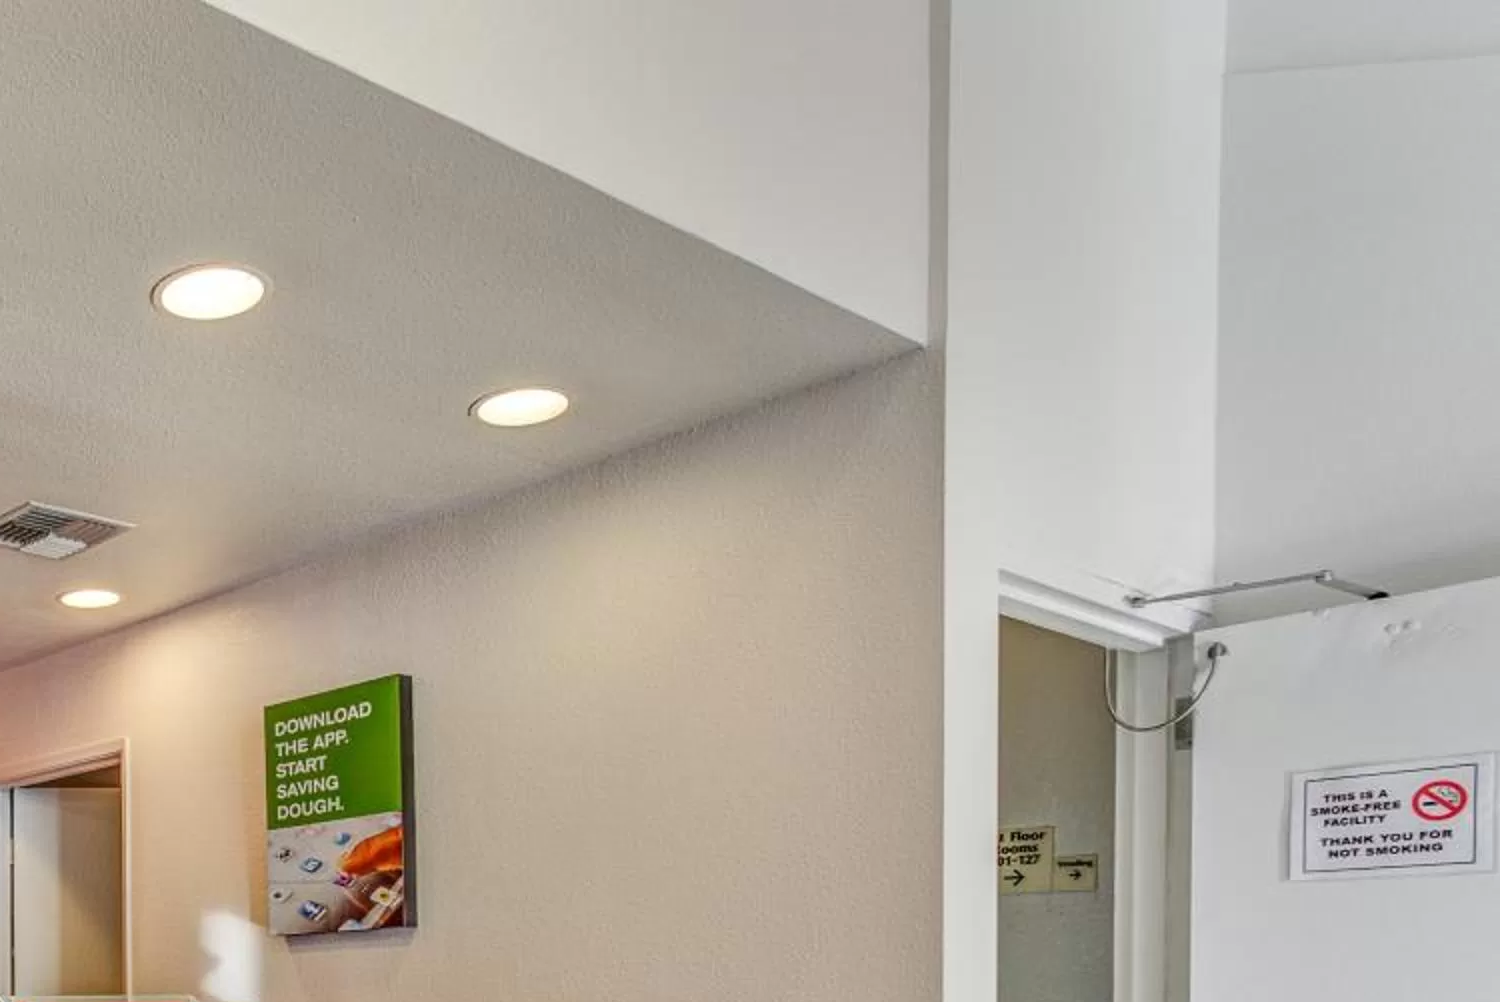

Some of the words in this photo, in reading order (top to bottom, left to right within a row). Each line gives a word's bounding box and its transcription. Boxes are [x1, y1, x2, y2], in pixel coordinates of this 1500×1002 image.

[275, 701, 372, 737] DOWNLOAD
[275, 737, 309, 758] THE
[313, 730, 349, 750] APP.
[276, 755, 328, 778] START
[276, 775, 340, 800] SAVING
[1324, 791, 1355, 804] THIS
[1359, 791, 1374, 800] IS
[1377, 789, 1389, 798] A
[277, 796, 344, 820] DOUGH.
[1310, 800, 1402, 816] SMOKE-FREE
[1323, 814, 1387, 827] FACILITY
[1320, 835, 1374, 847] THANK
[1381, 831, 1413, 843] YOU
[1419, 829, 1453, 840] FOR
[1328, 848, 1360, 858] NOT
[1366, 842, 1443, 857] SMOKING
